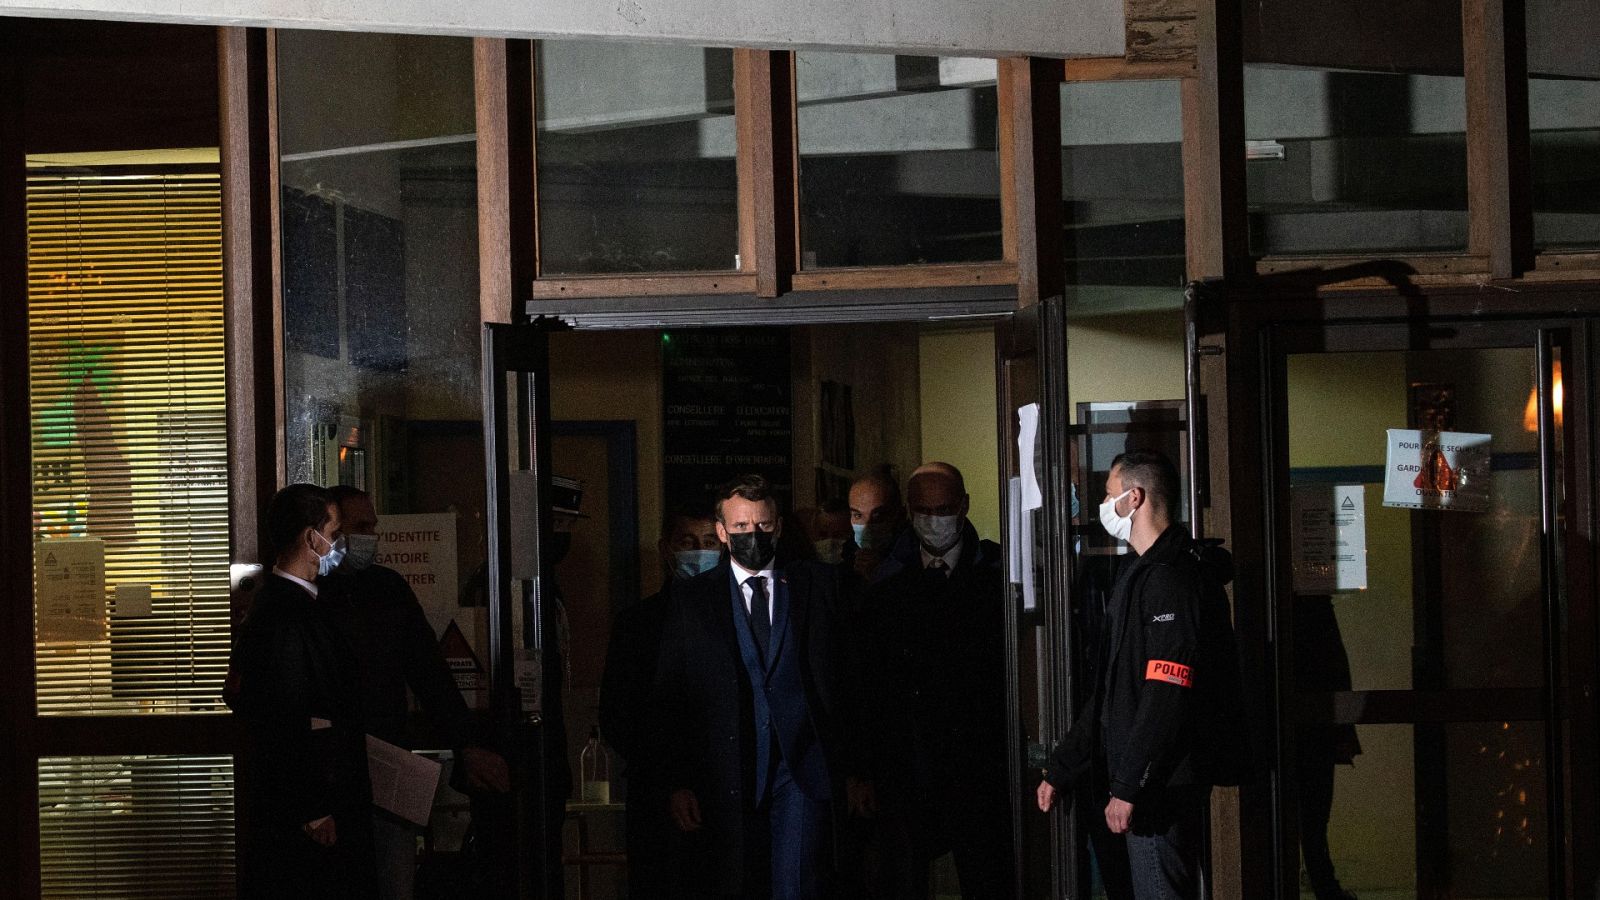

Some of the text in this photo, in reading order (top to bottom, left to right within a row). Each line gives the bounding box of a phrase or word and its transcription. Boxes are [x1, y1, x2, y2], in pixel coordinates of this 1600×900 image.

[1398, 441, 1420, 450] POUR
[374, 552, 430, 564] GATOIRE
[1154, 662, 1193, 681] POLICE
